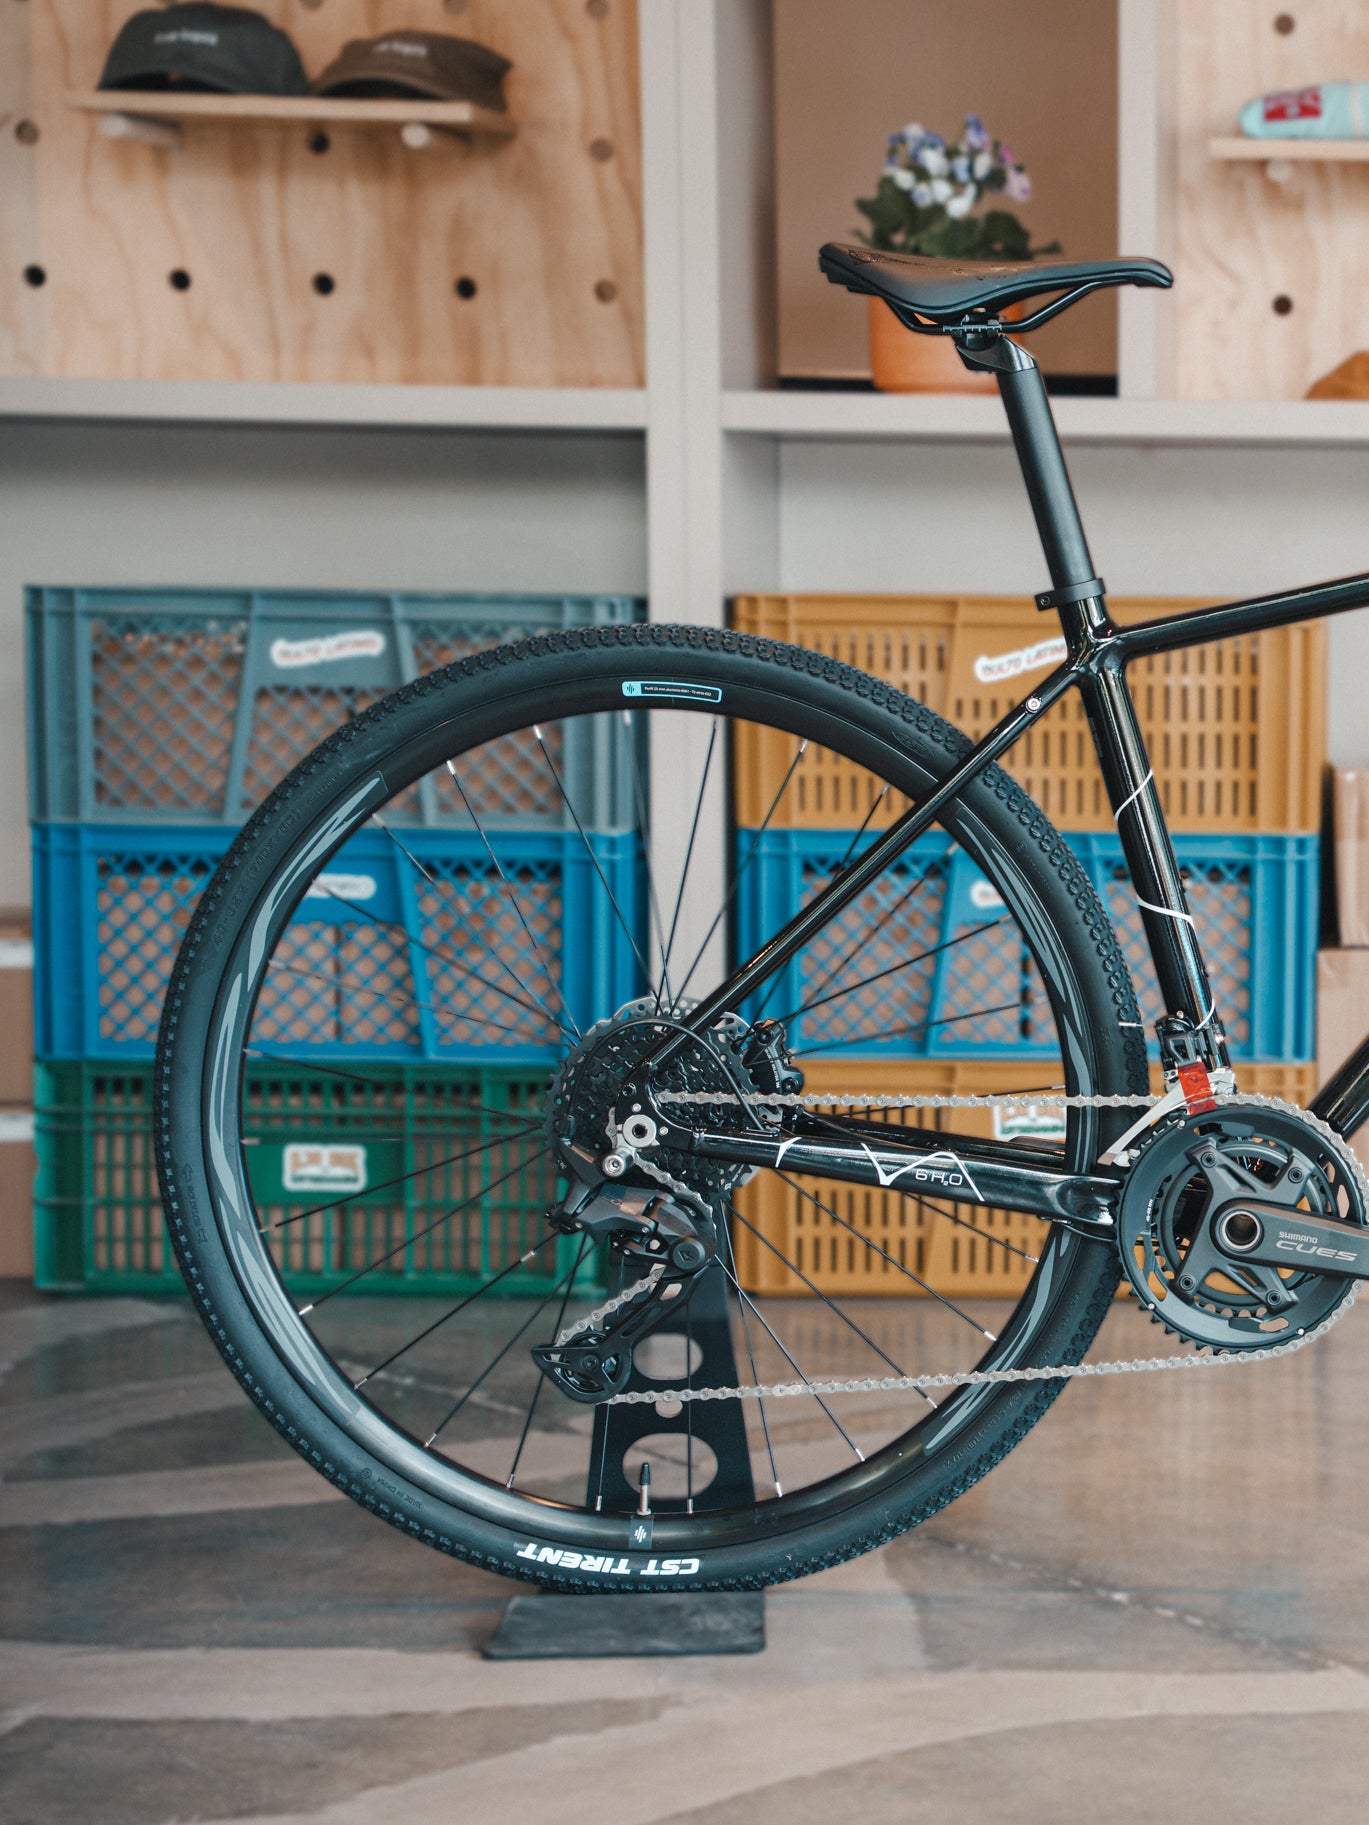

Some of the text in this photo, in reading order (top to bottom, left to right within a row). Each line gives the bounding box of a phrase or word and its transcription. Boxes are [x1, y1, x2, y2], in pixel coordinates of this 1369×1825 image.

[1279, 1231, 1318, 1244] SHIMANO
[1275, 1240, 1358, 1262] CUES
[516, 1542, 701, 1576] CST TIRENT
